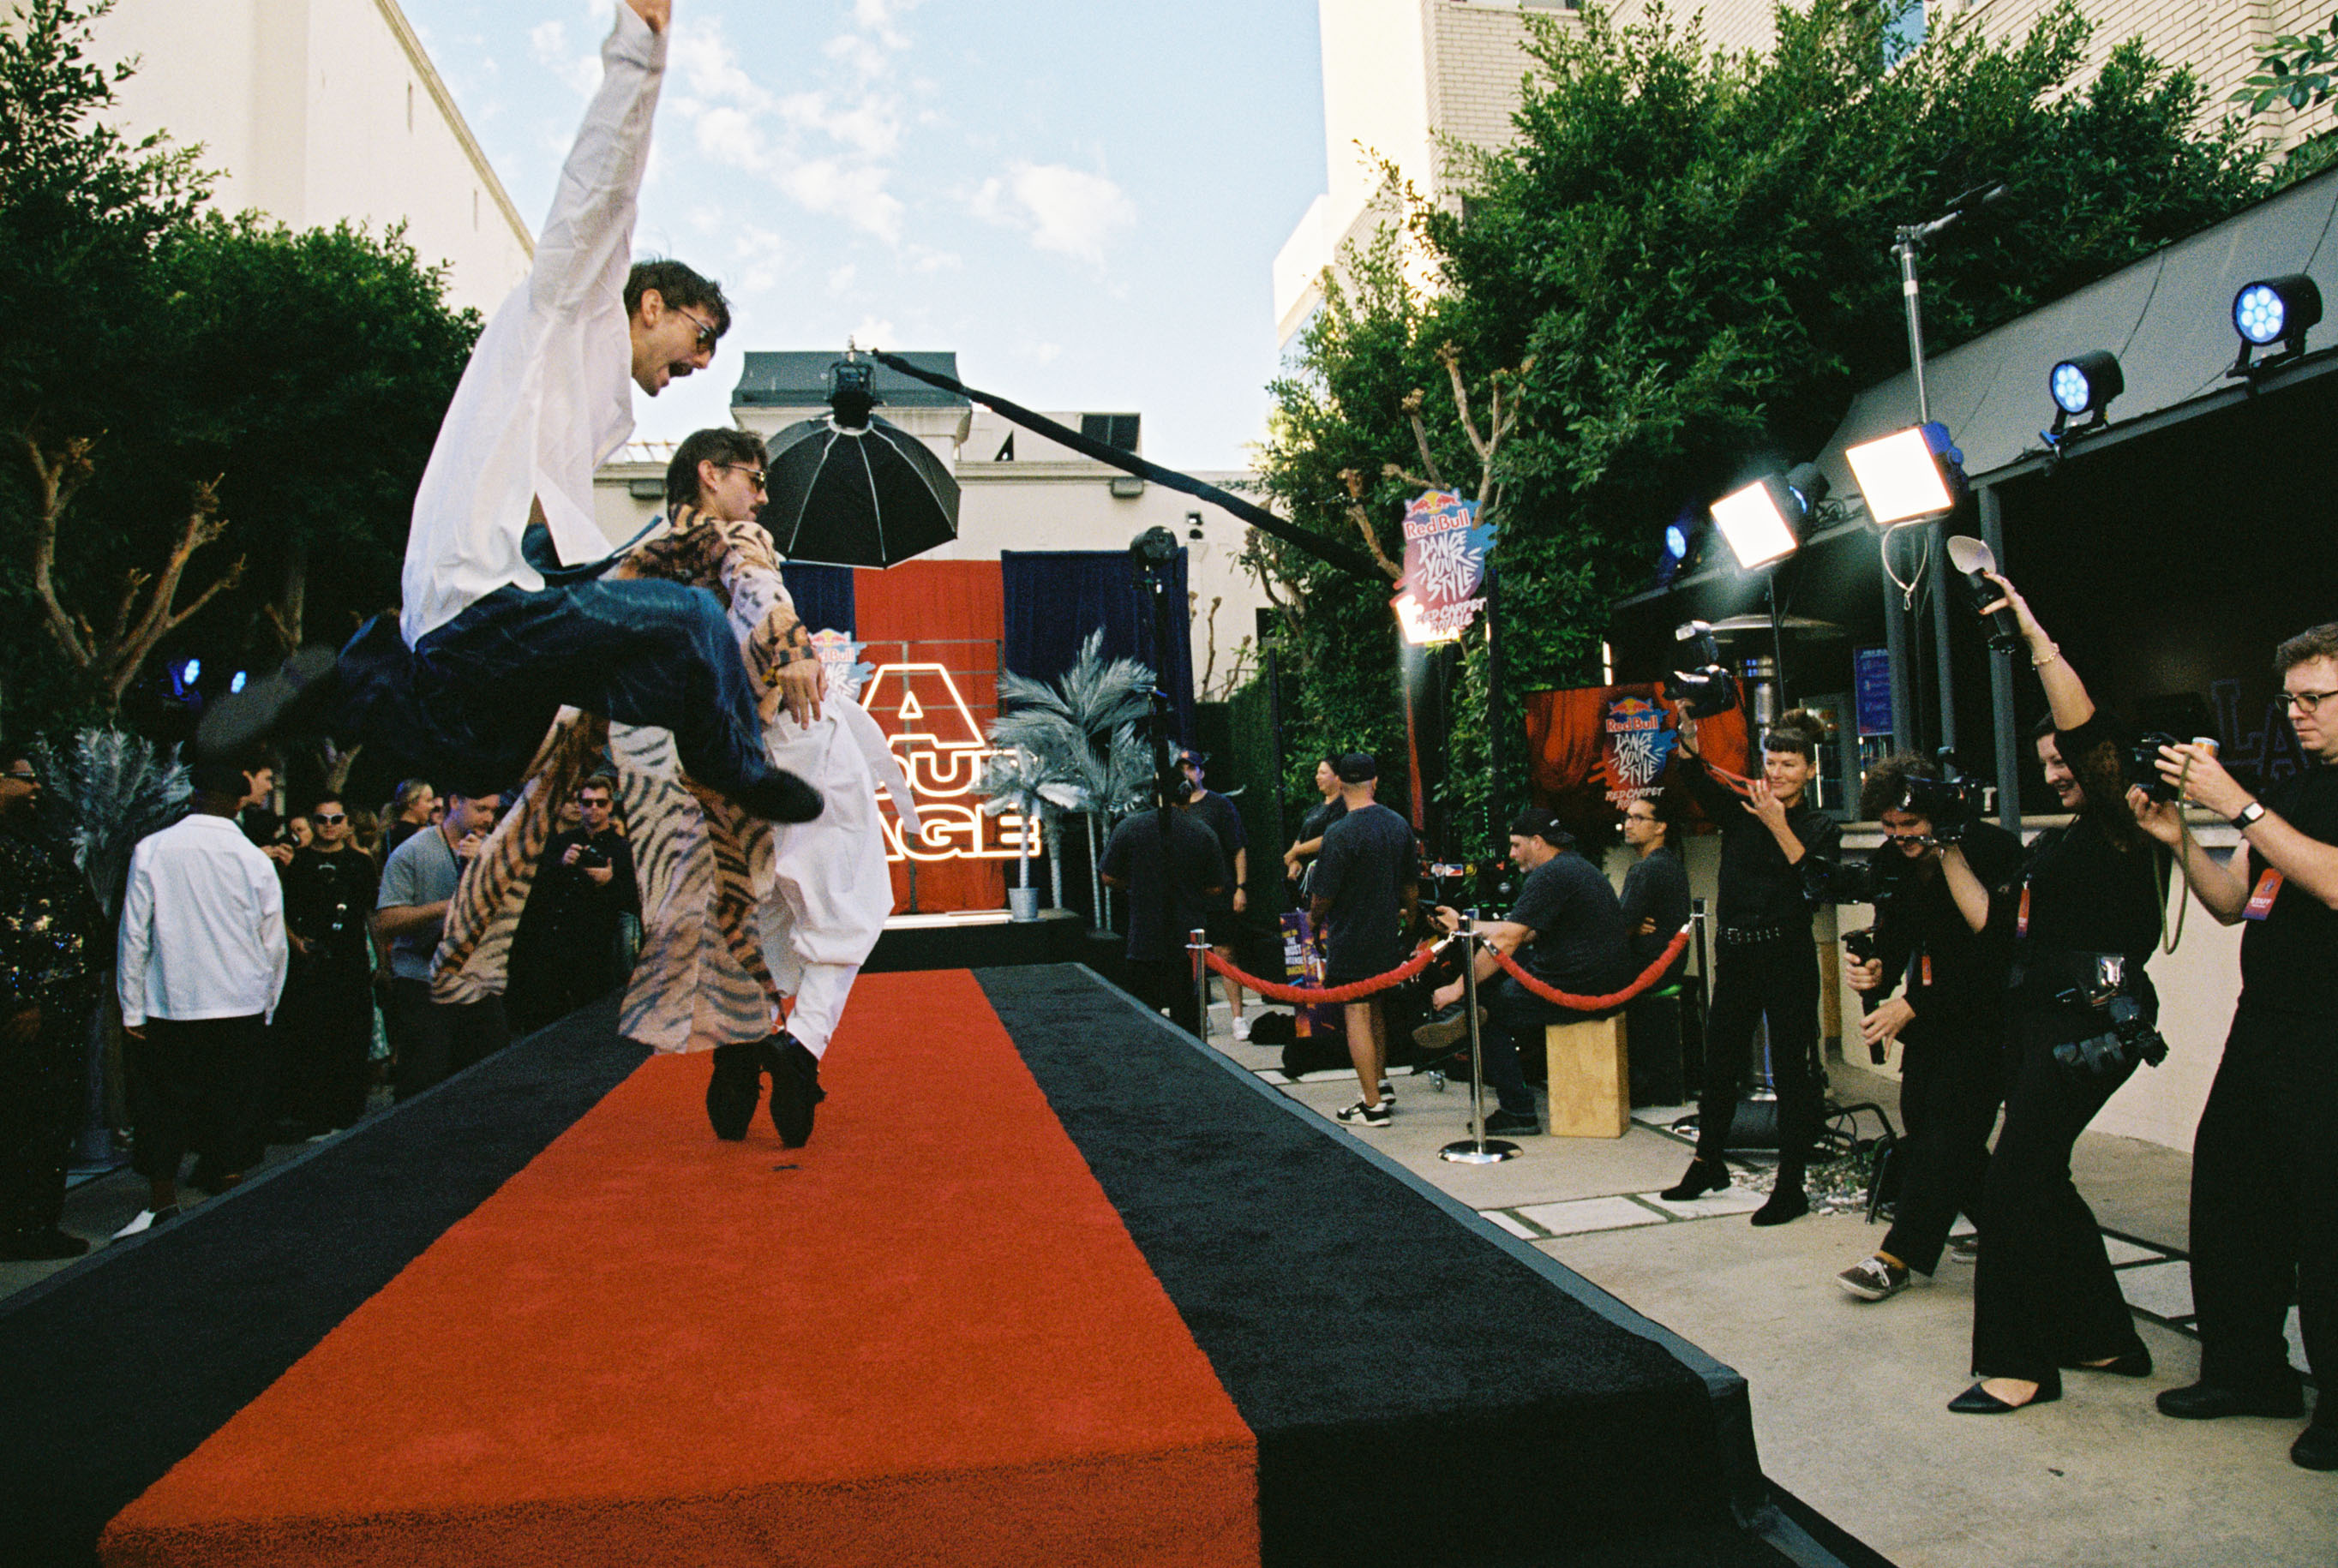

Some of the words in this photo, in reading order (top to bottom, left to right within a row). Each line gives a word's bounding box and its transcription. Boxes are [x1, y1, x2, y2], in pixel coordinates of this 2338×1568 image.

[1406, 516, 1437, 539] Red
[1438, 509, 1470, 531] Bull
[1417, 530, 1467, 565] DANCE
[1425, 546, 1478, 581] YOUR
[1426, 566, 1476, 603] STYLE
[1440, 597, 1487, 619] CARPET
[829, 647, 855, 661] Bull
[1606, 718, 1632, 733] Red
[1633, 715, 1658, 731] Bull
[1615, 732, 1654, 753] DANCE
[1619, 744, 1660, 767] YOUR
[1618, 763, 1657, 787] STYLE
[1605, 789, 1627, 802] RED
[1627, 787, 1665, 799] CARPET
